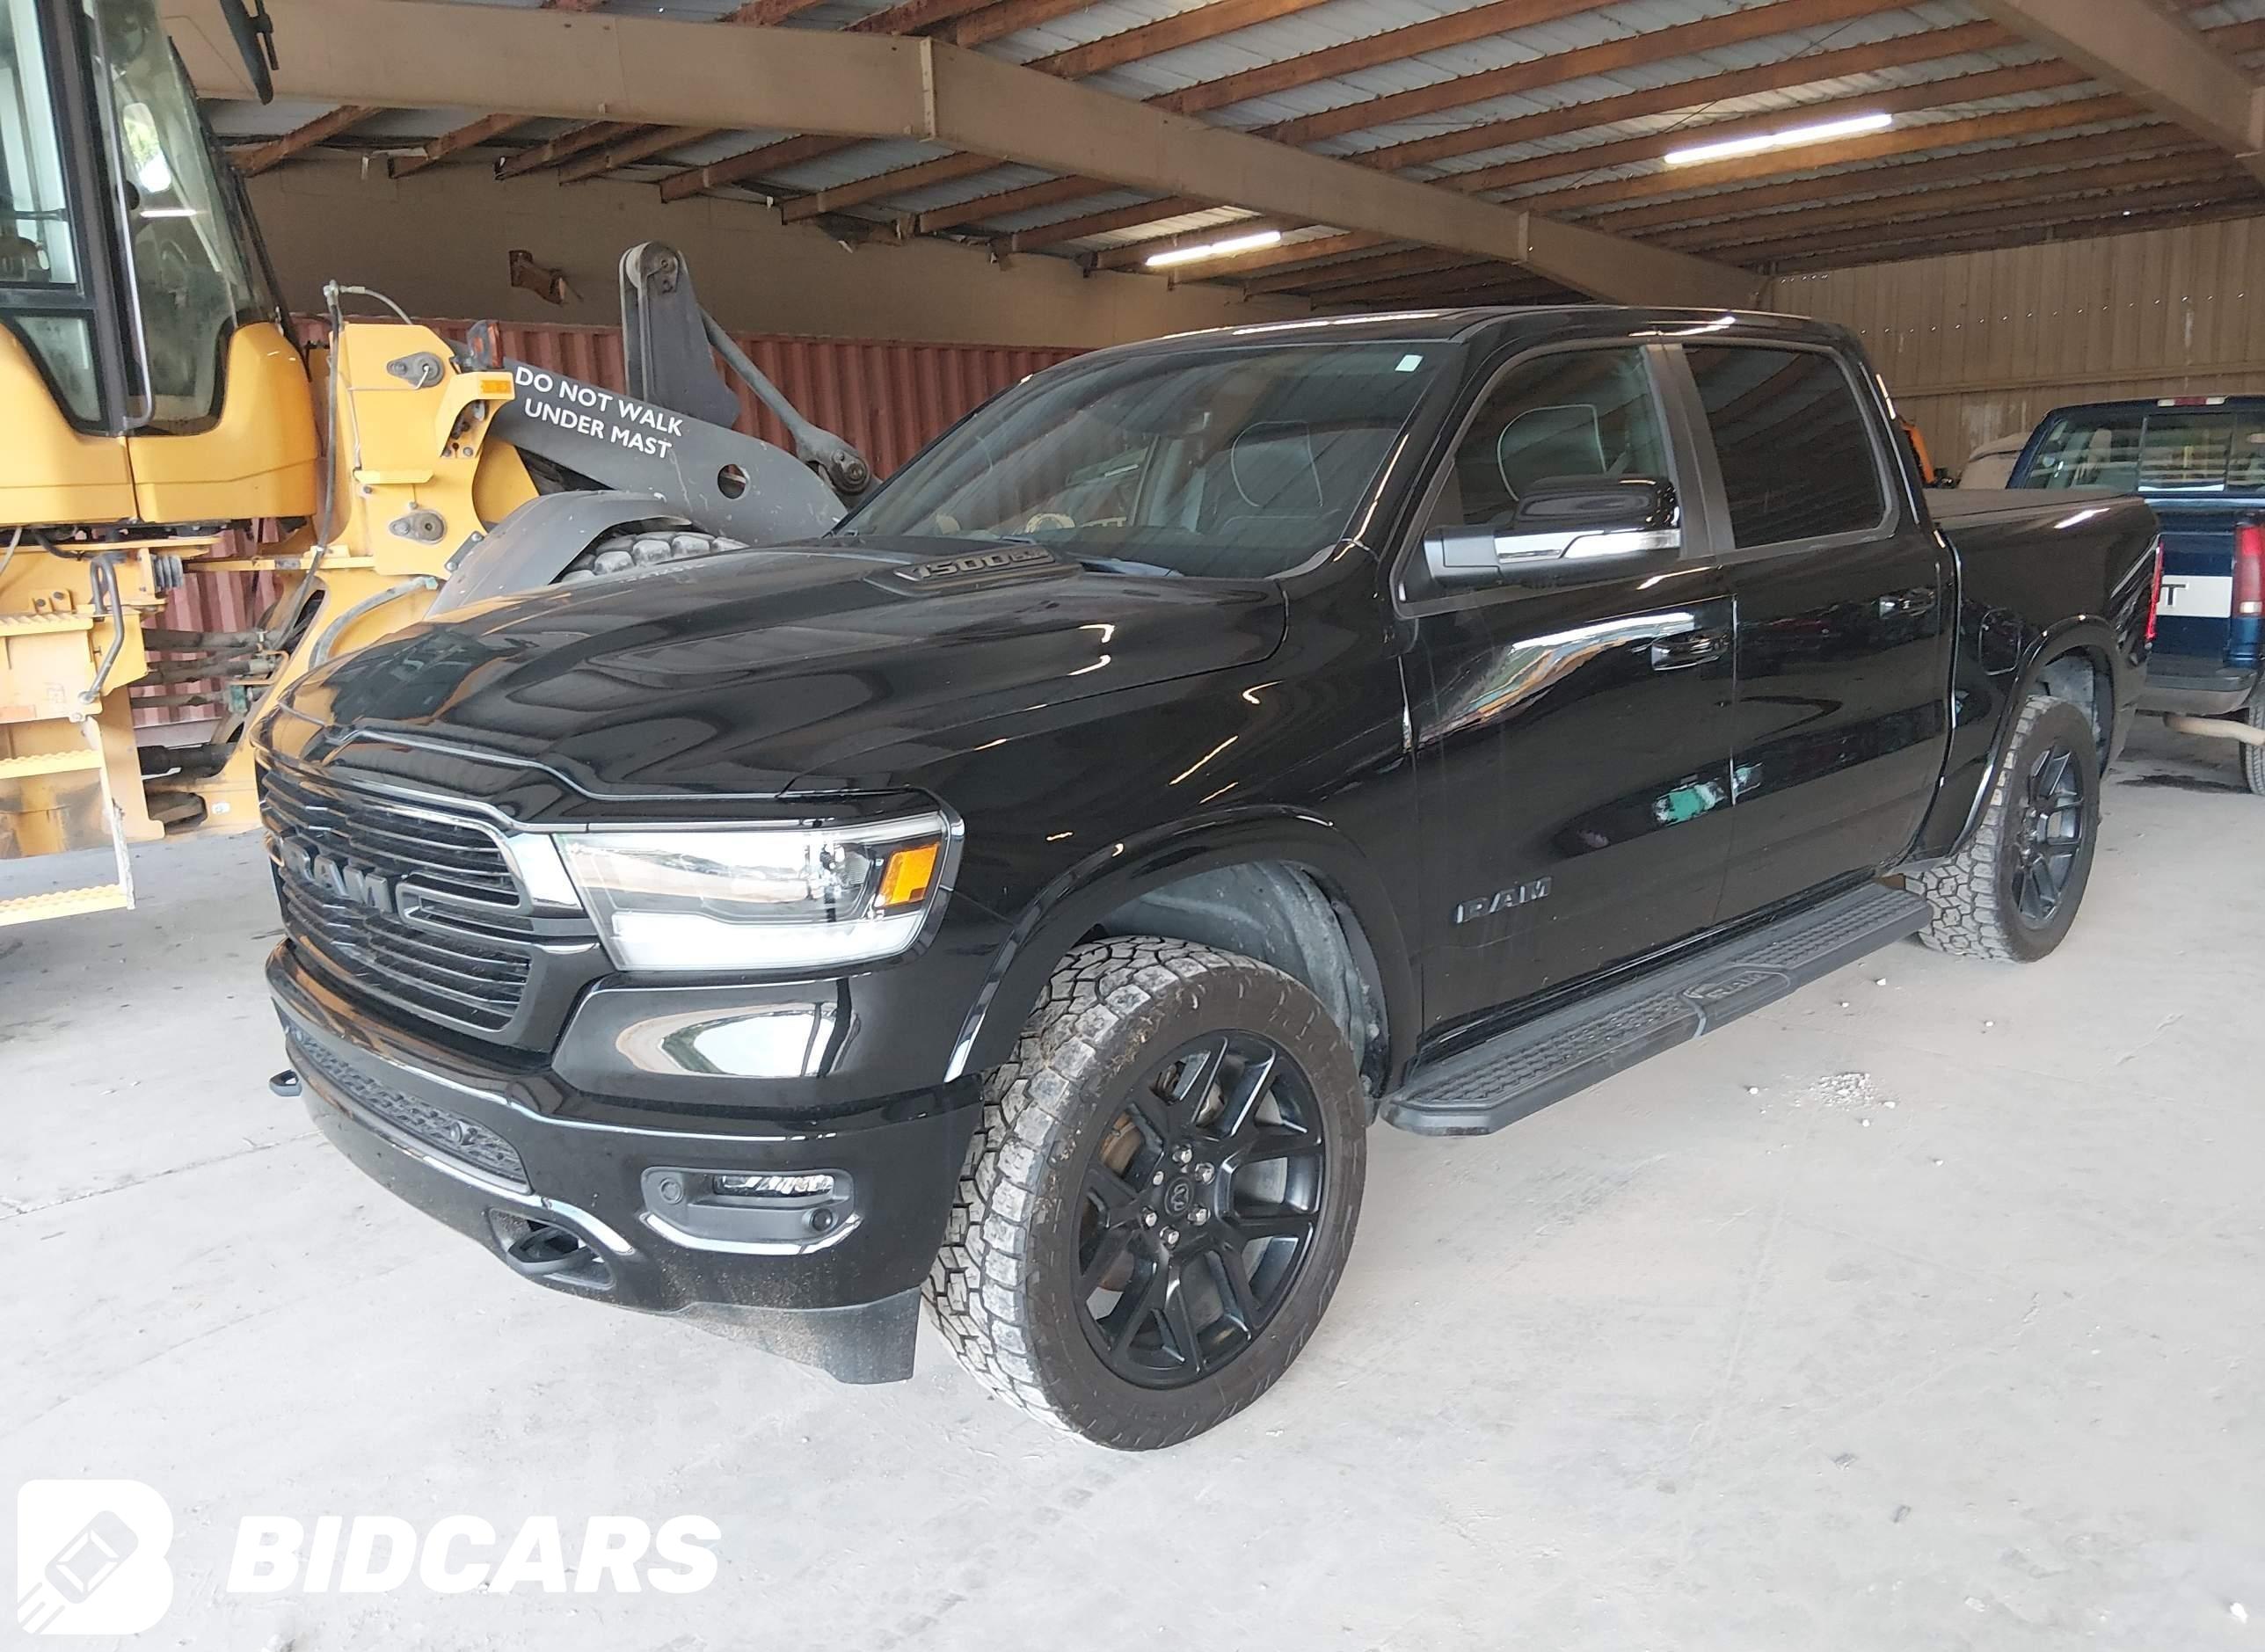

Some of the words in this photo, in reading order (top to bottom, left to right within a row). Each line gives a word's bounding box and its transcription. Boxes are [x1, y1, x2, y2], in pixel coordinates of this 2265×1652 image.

[515, 366, 553, 392] DO
[558, 381, 614, 412] NOT
[618, 399, 683, 437] WALK
[524, 398, 605, 439] UNDER
[610, 426, 673, 458] MAST
[915, 552, 1011, 579] 1500
[280, 837, 393, 913] RAM
[1456, 877, 1552, 923] RAM
